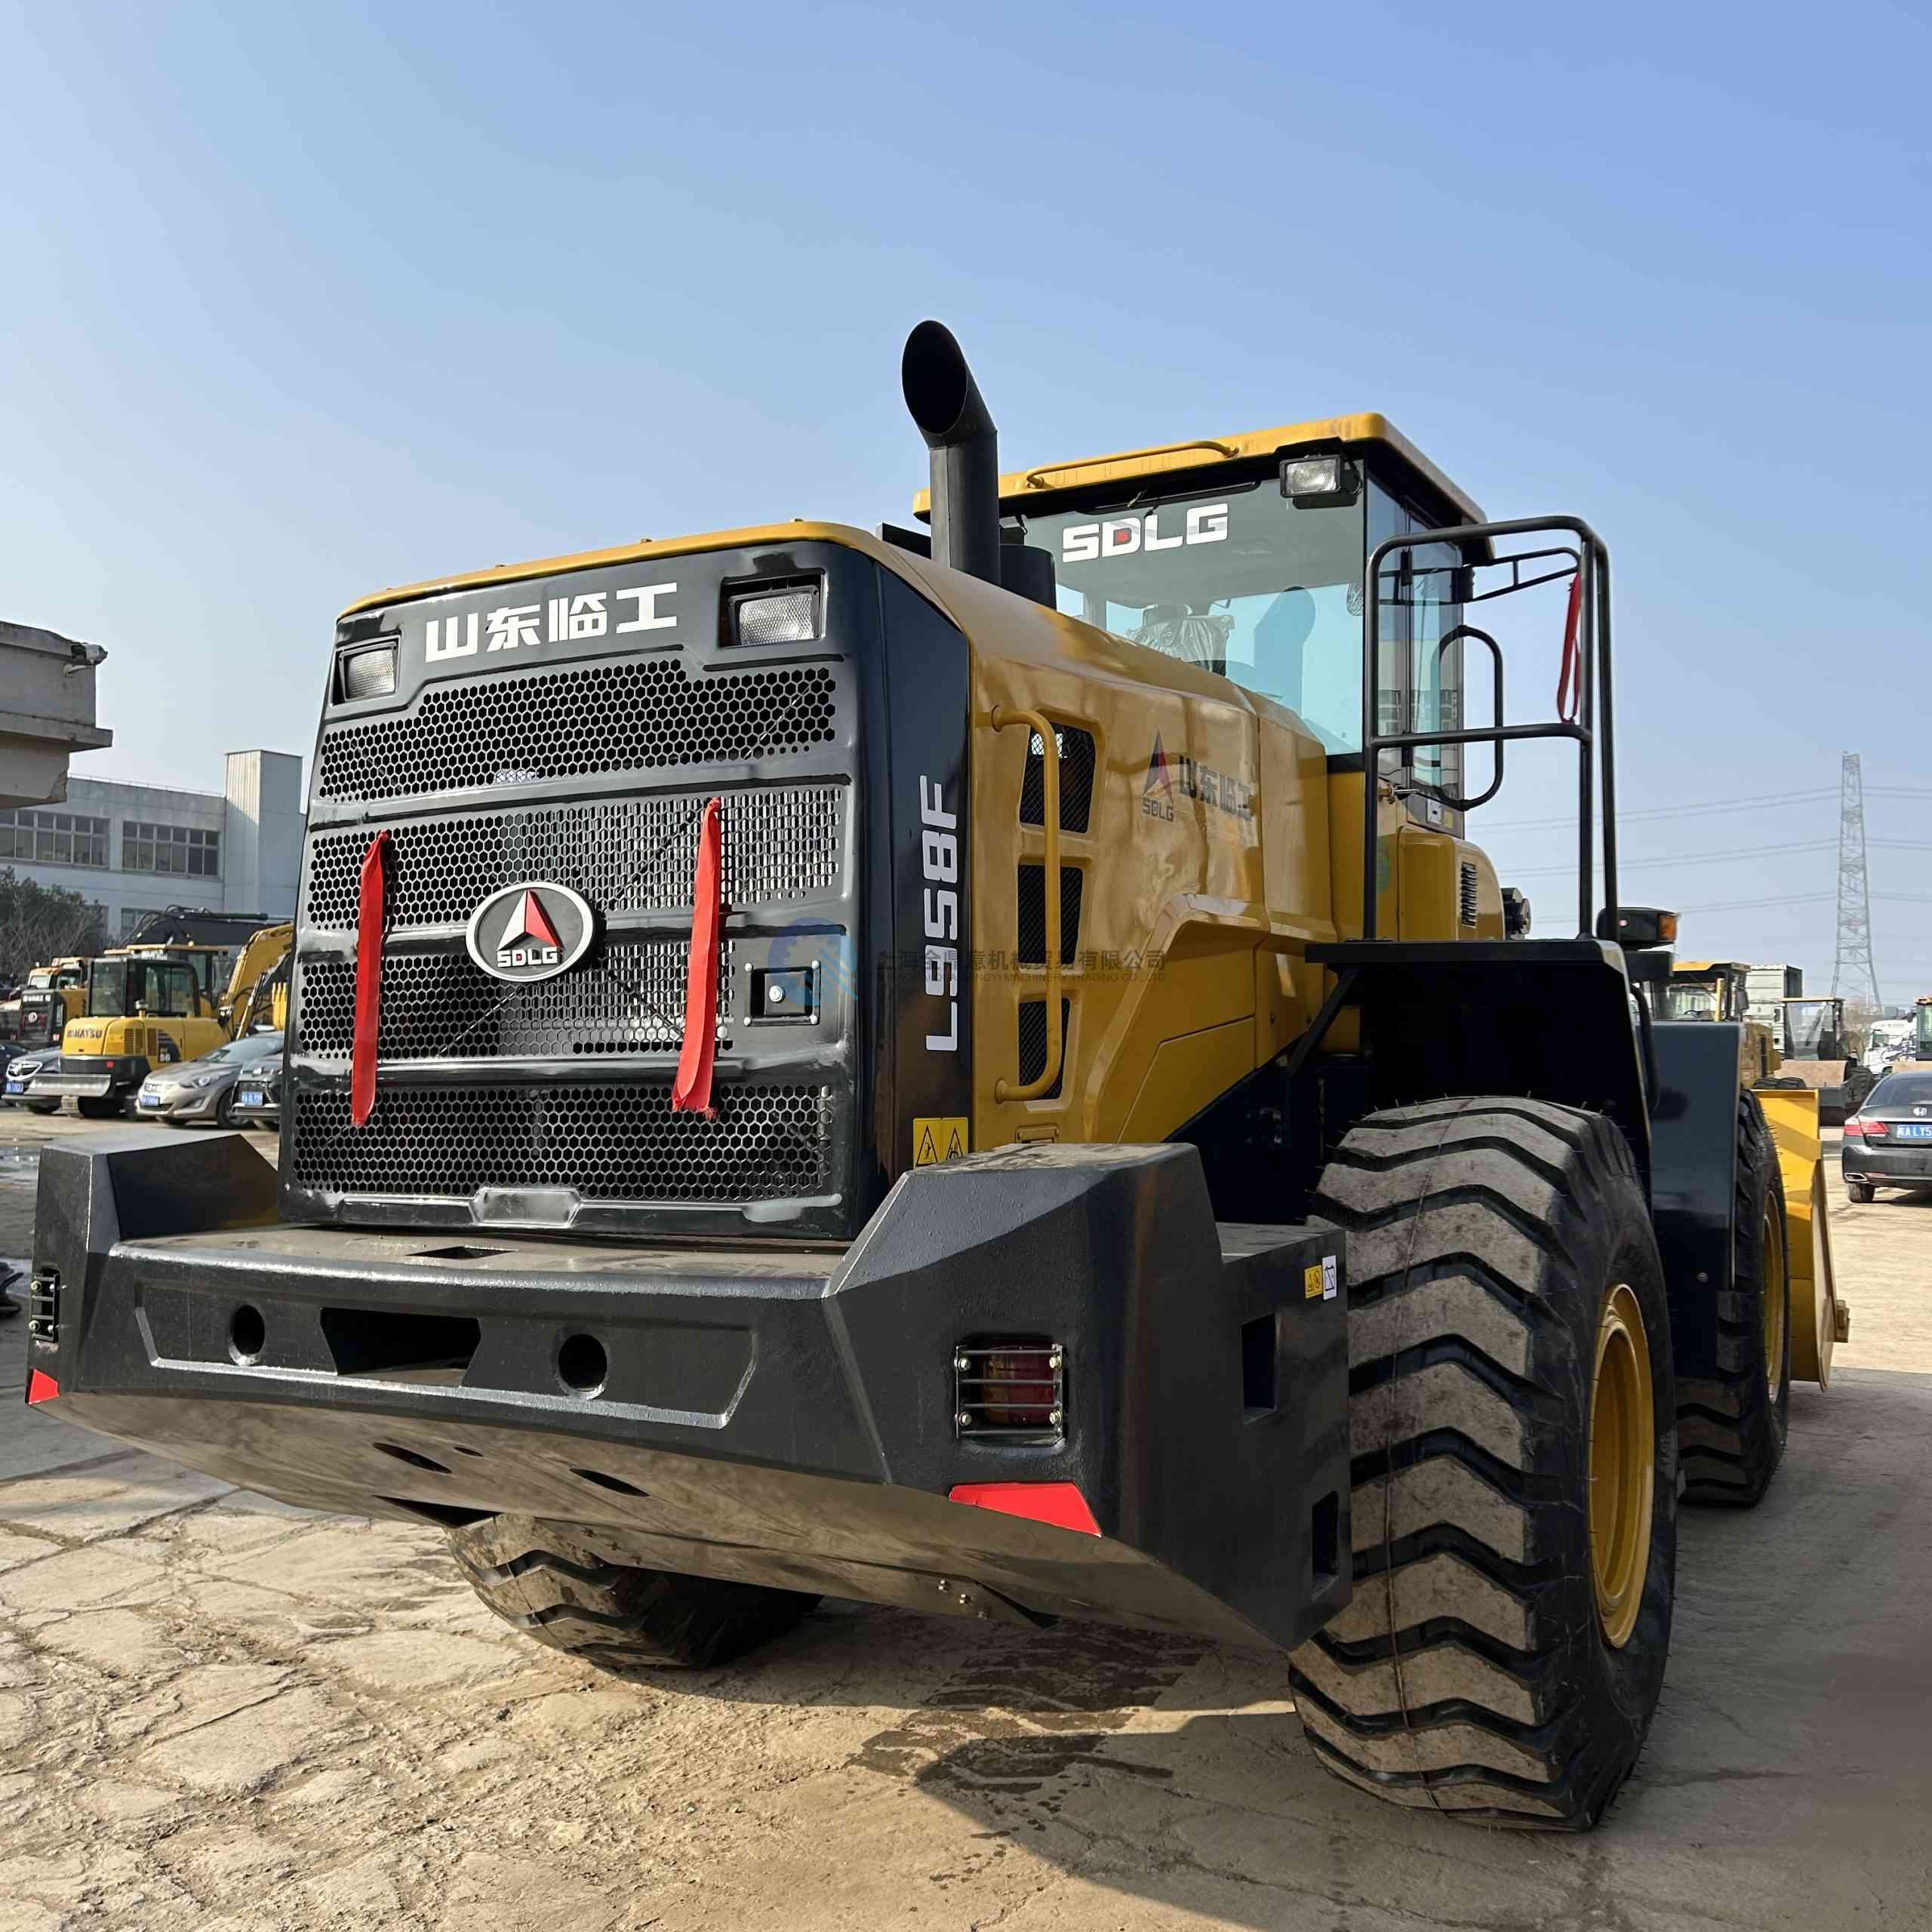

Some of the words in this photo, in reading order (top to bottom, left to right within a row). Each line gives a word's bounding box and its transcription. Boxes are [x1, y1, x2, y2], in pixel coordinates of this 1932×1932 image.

[1062, 503, 1229, 563] SDLG
[425, 582, 678, 663] 山东临工
[1143, 798, 1174, 822] SDLG
[919, 774, 958, 1051] L958F
[497, 946, 558, 968] SDLG
[66, 1029, 103, 1038] KOMATSU
